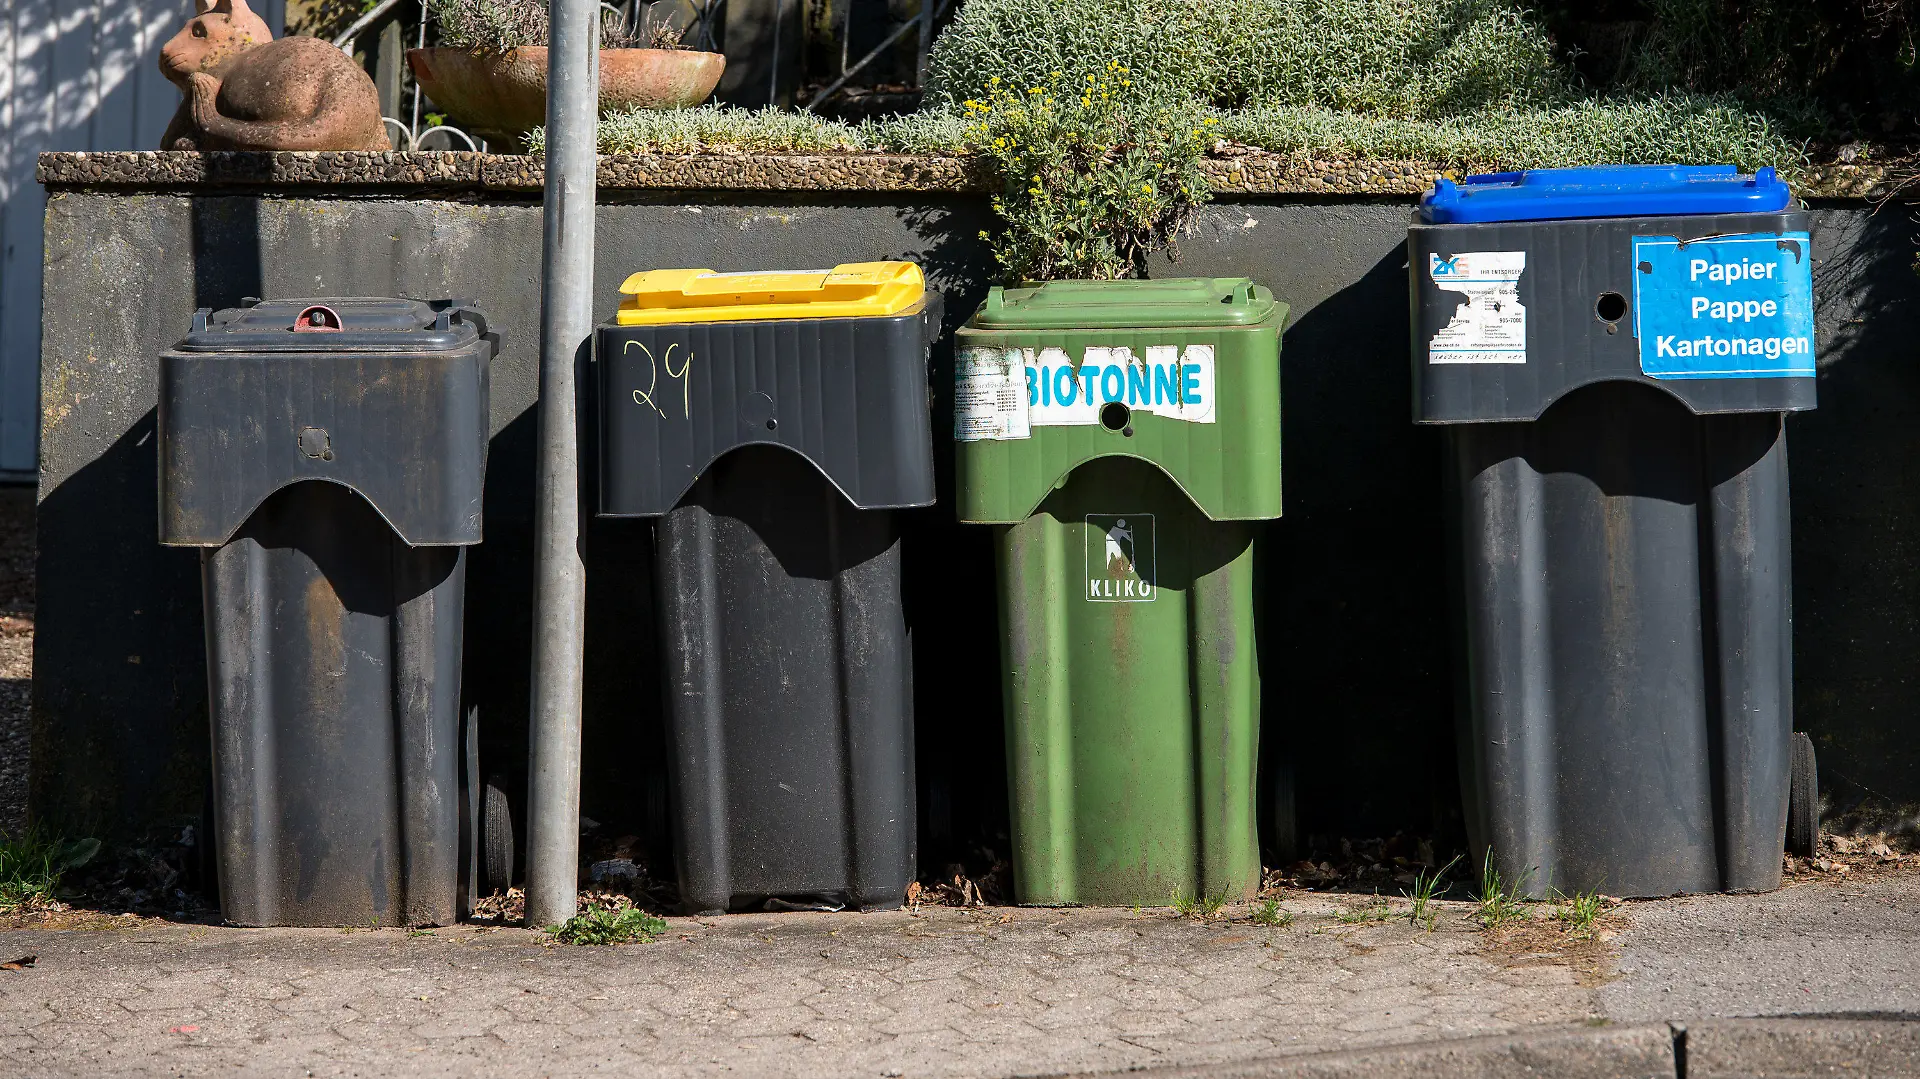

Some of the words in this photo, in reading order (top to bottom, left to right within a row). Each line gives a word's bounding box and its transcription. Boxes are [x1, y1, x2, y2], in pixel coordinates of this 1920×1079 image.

[1690, 258, 1777, 286] Papier
[1691, 297, 1777, 322] Pappe
[1656, 335, 1808, 359] Kartonagen
[623, 340, 694, 419] 29
[1025, 364, 1202, 407] BIOTONNE
[1090, 579, 1151, 597] KLIKO
